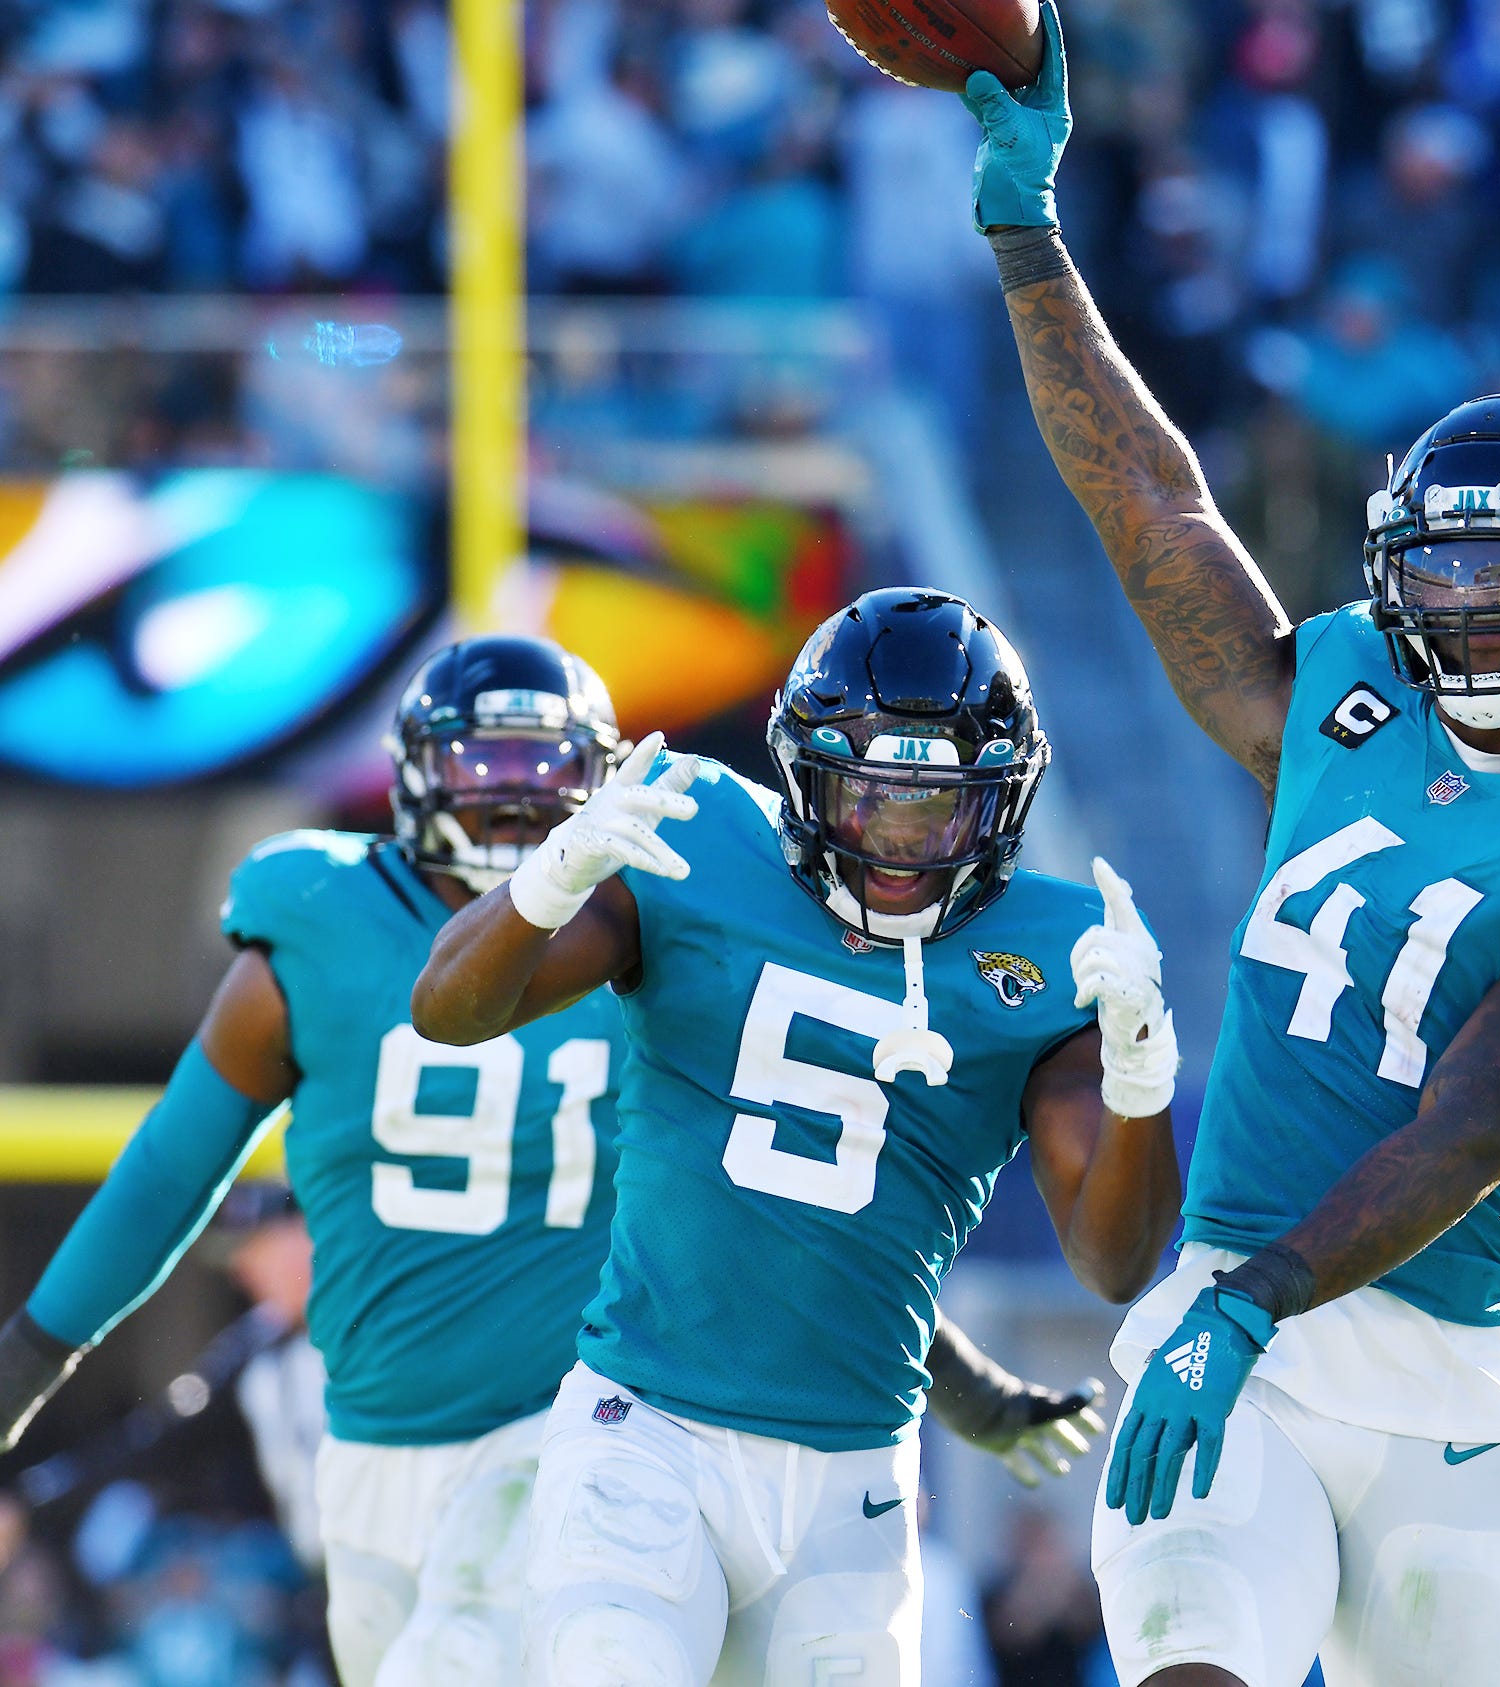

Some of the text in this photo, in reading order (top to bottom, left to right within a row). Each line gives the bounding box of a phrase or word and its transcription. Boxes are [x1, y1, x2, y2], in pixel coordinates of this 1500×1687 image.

[1452, 489, 1490, 510] JAX
[1334, 689, 1391, 735] C
[892, 739, 931, 761] JAX
[1239, 815, 1485, 1089] 41
[722, 961, 905, 1214] 5
[371, 1022, 611, 1236] 91
[1189, 1331, 1212, 1391] adidas
[597, 1408, 620, 1420] NFL
